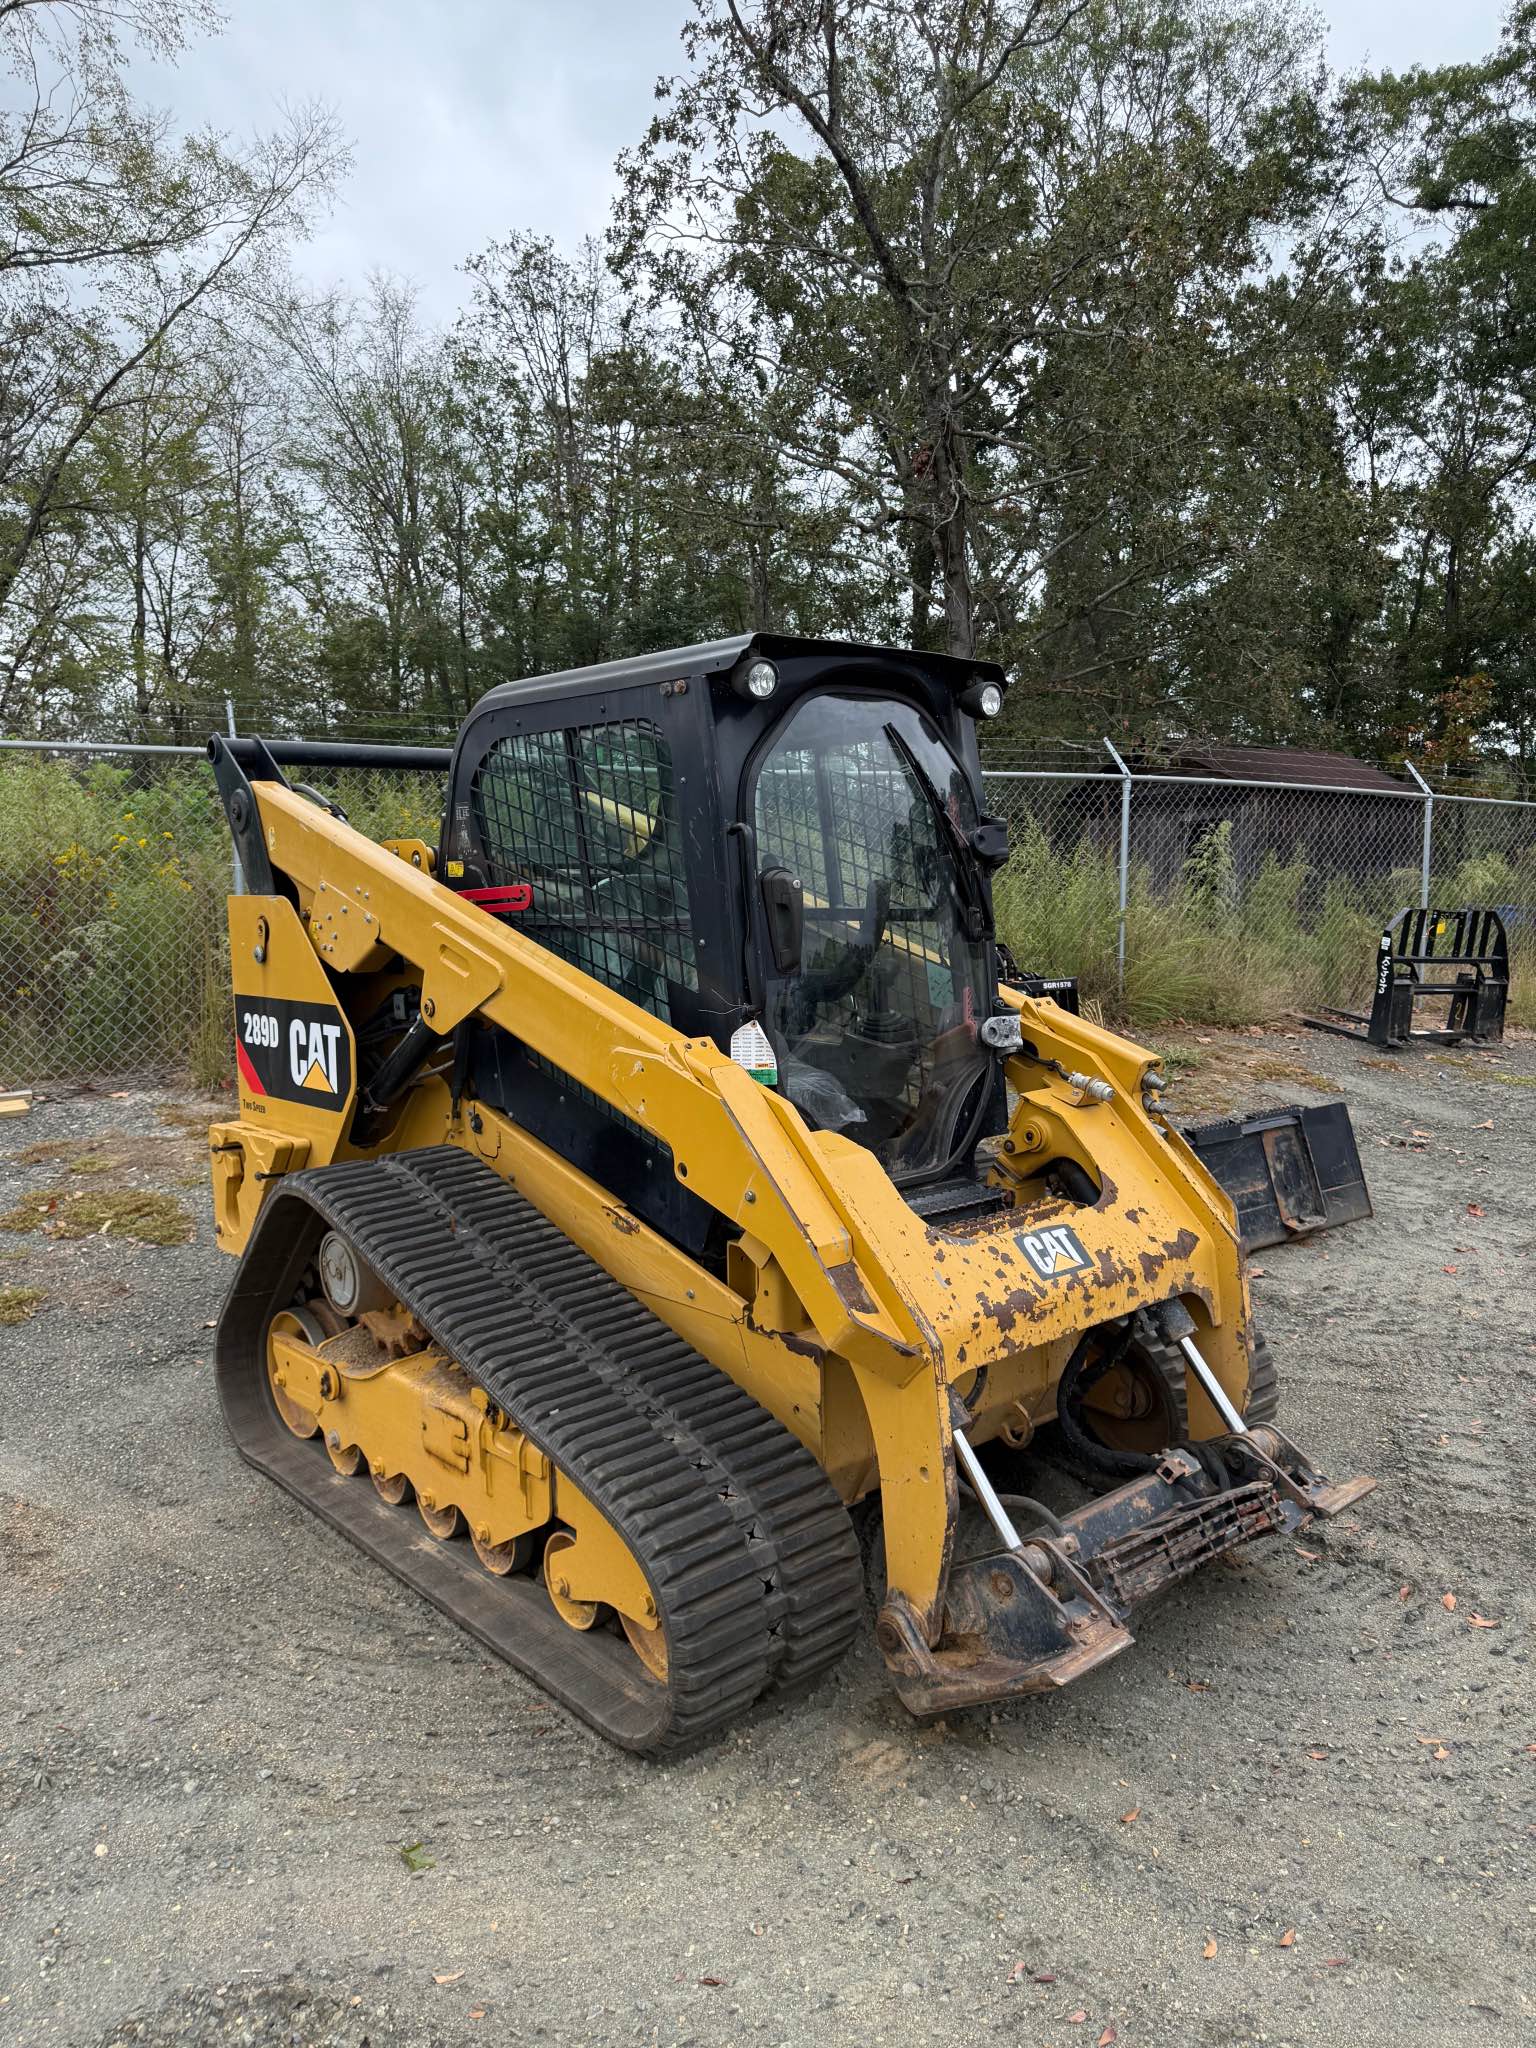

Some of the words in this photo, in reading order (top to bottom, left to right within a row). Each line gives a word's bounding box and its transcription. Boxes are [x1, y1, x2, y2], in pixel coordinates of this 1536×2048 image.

[1378, 956, 1391, 994] Kubota
[243, 1012, 279, 1048] 289D
[289, 1019, 341, 1094] CAT
[1023, 1227, 1085, 1275] CAT
